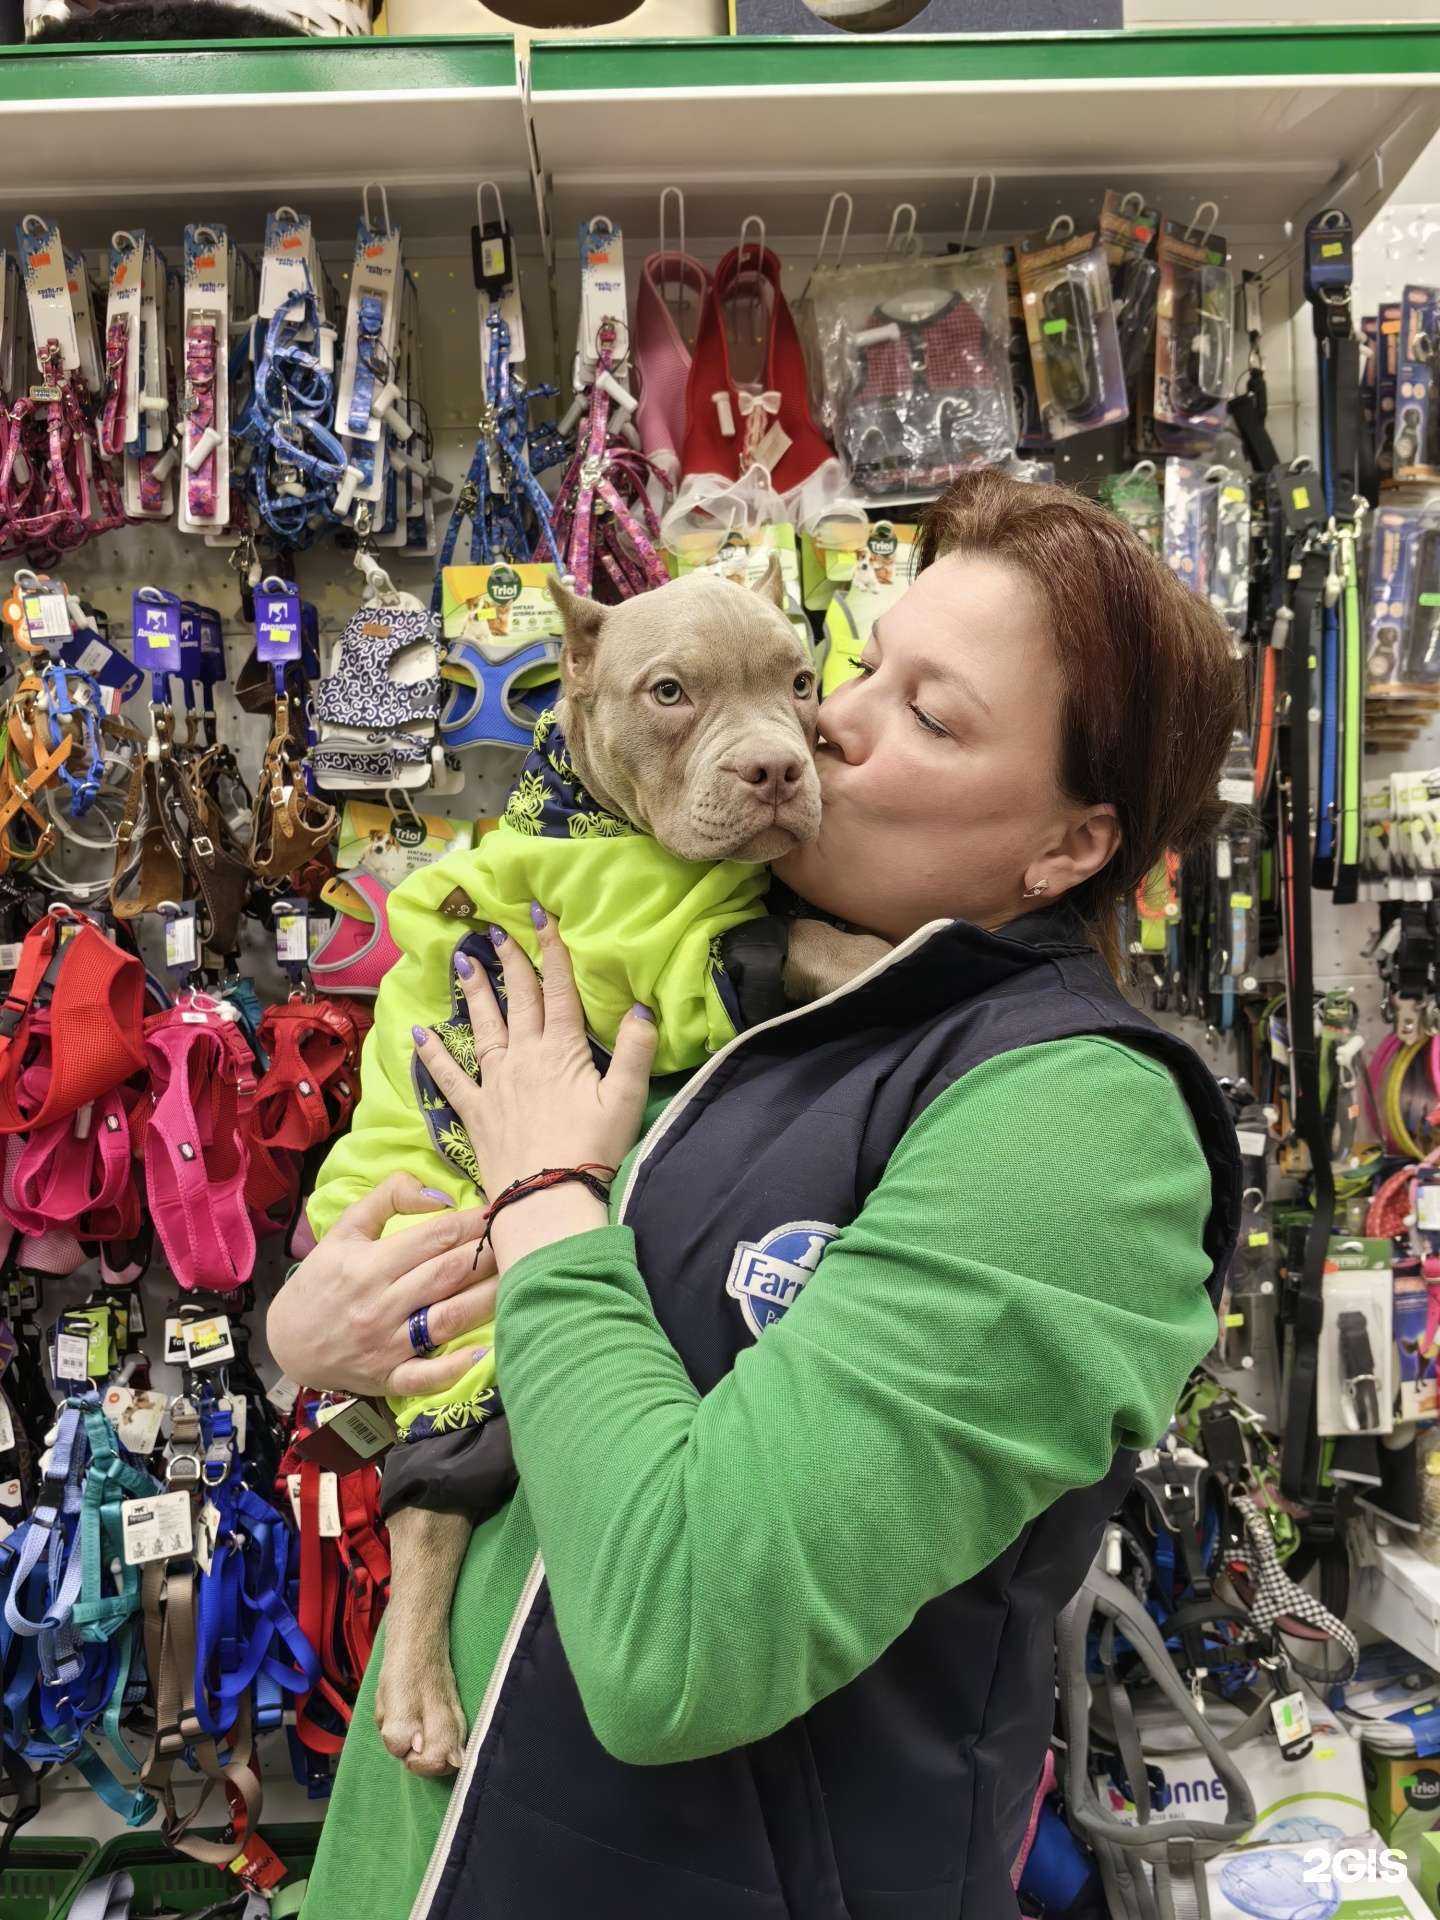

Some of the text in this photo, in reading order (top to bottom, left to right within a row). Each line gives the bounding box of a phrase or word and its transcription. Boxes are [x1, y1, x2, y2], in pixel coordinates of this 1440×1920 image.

[871, 540, 894, 553] Triol
[491, 584, 518, 597] Triol
[394, 828, 422, 841] Triol
